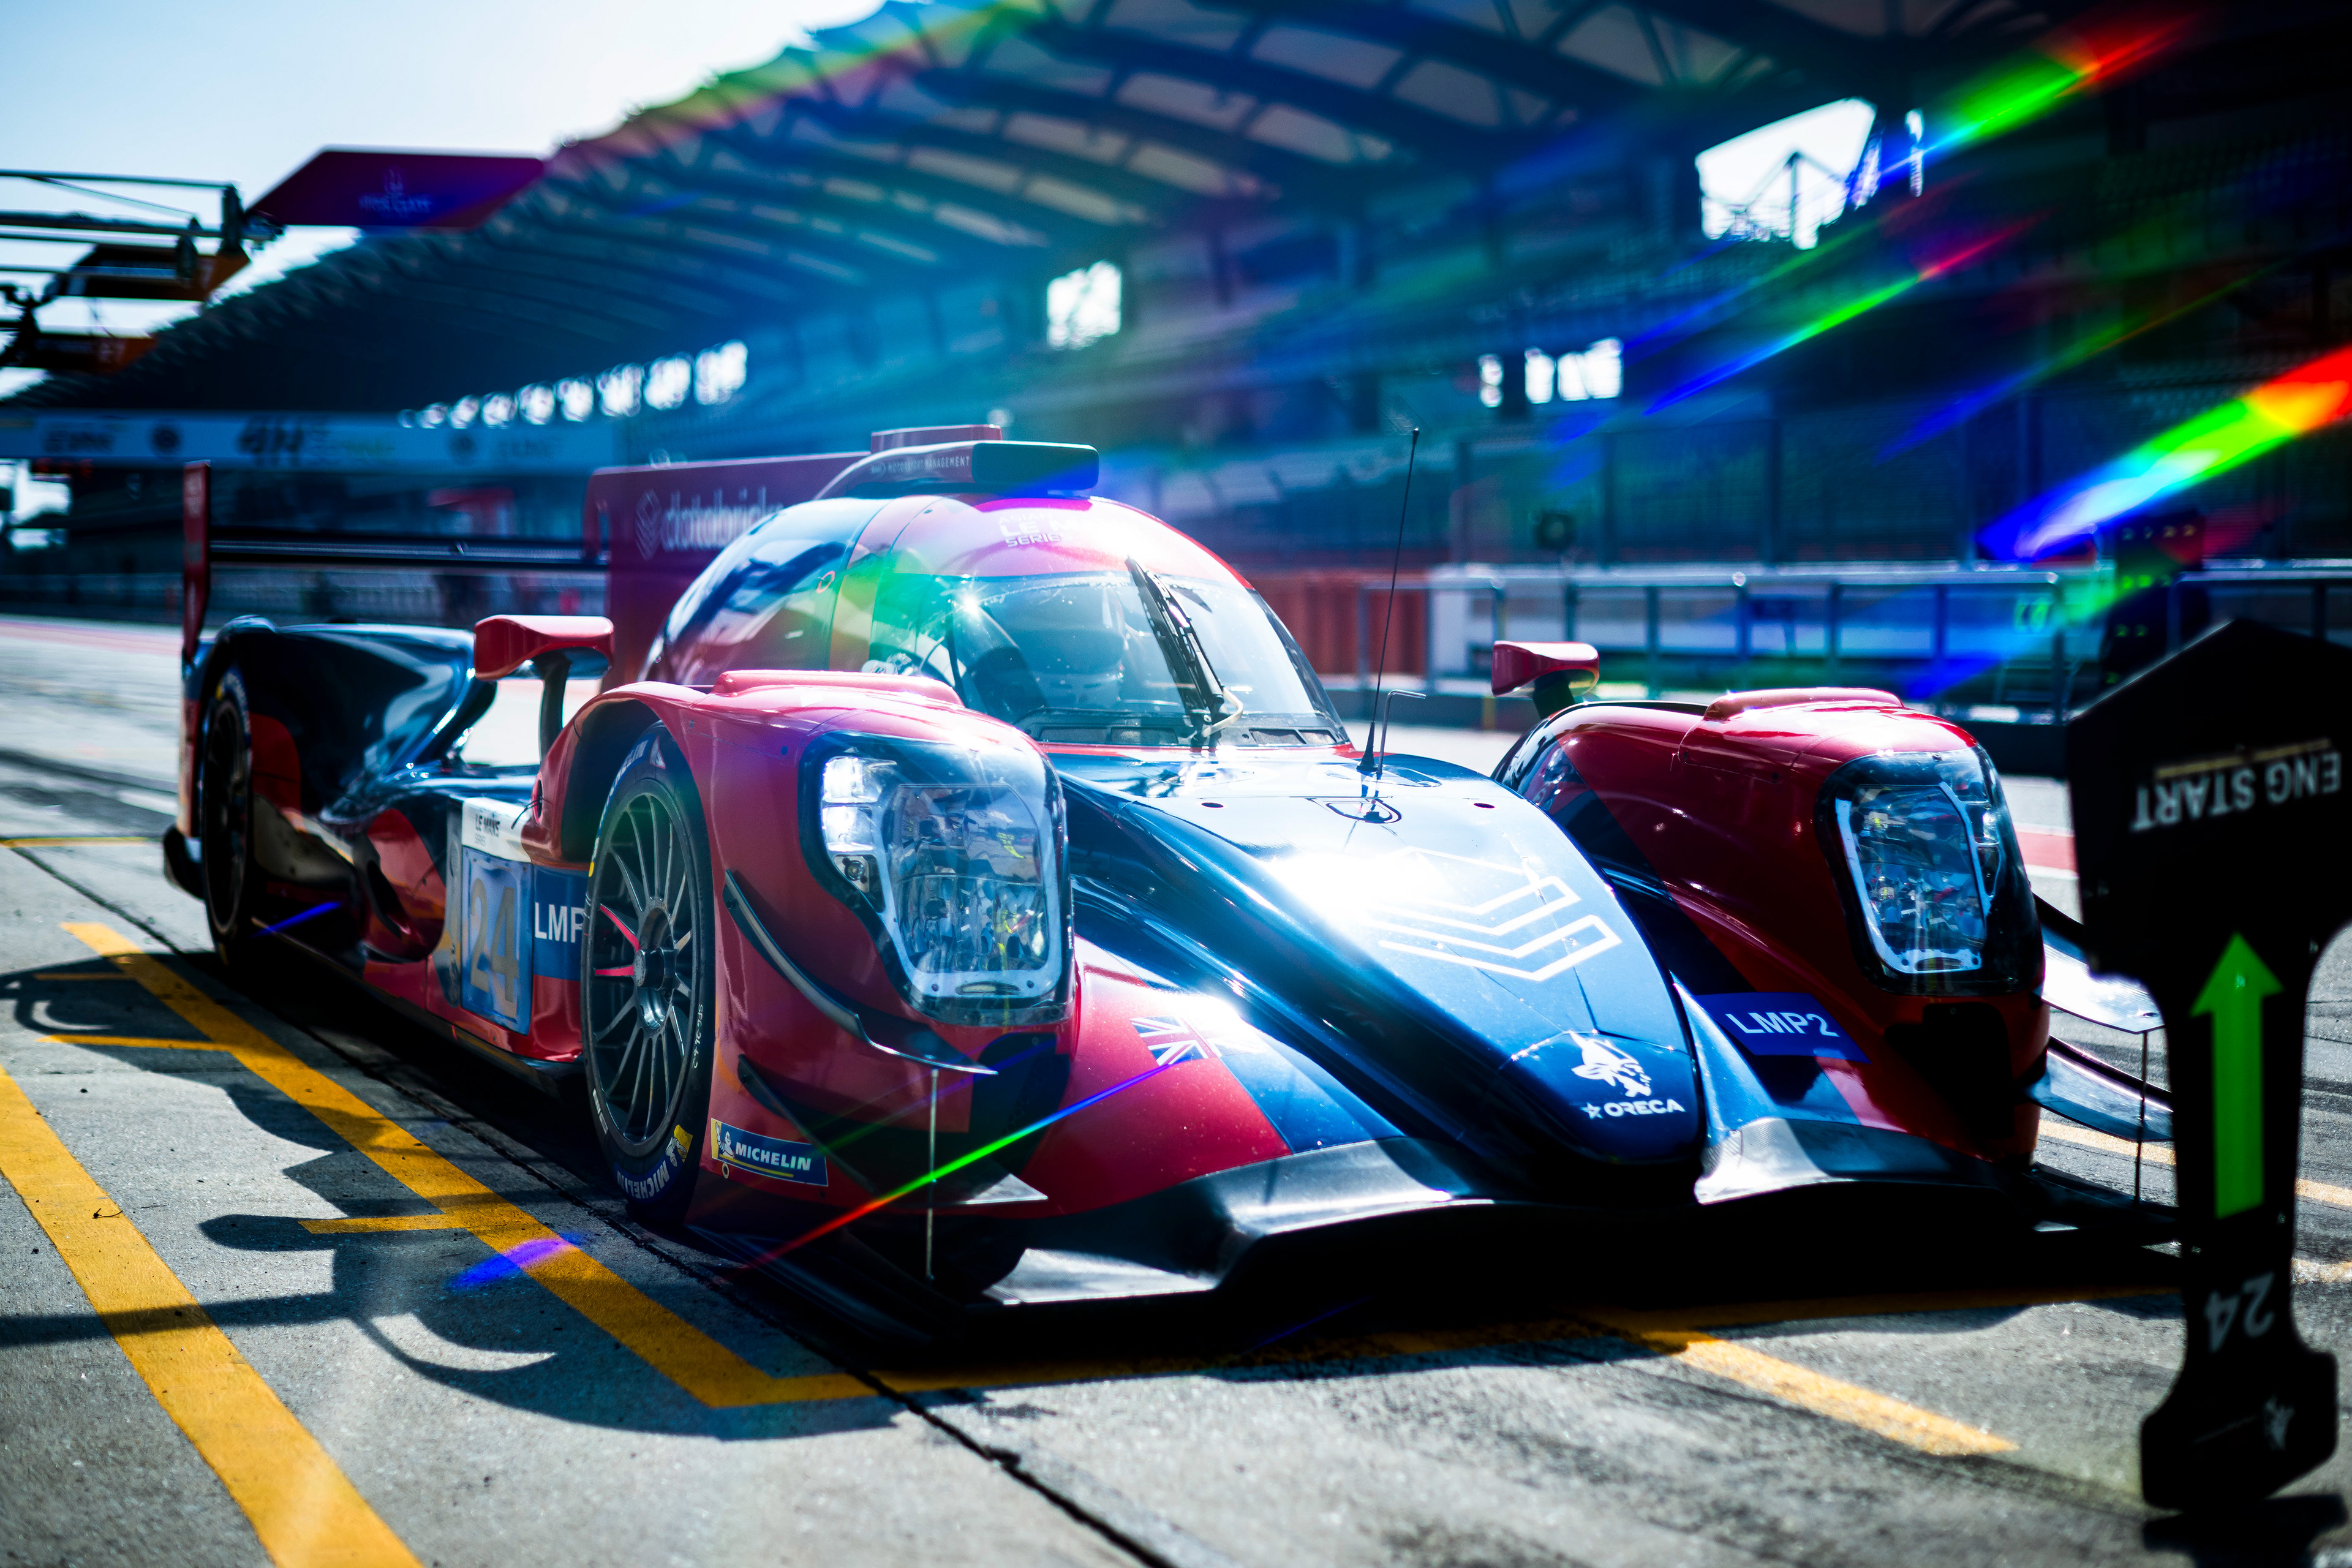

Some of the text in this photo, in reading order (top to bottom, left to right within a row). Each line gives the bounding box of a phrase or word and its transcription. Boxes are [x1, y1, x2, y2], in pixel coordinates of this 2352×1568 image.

[925, 456, 970, 469] MANAGEMENT
[2130, 752, 2341, 831] ENG START
[470, 878, 519, 1003] 24
[1725, 1012, 1840, 1038] LMP2
[1603, 1099, 1686, 1117] ORECA
[735, 1142, 812, 1171] MICHELIN
[617, 1160, 669, 1199] MICHELIN
[2204, 1271, 2275, 1353] 24
